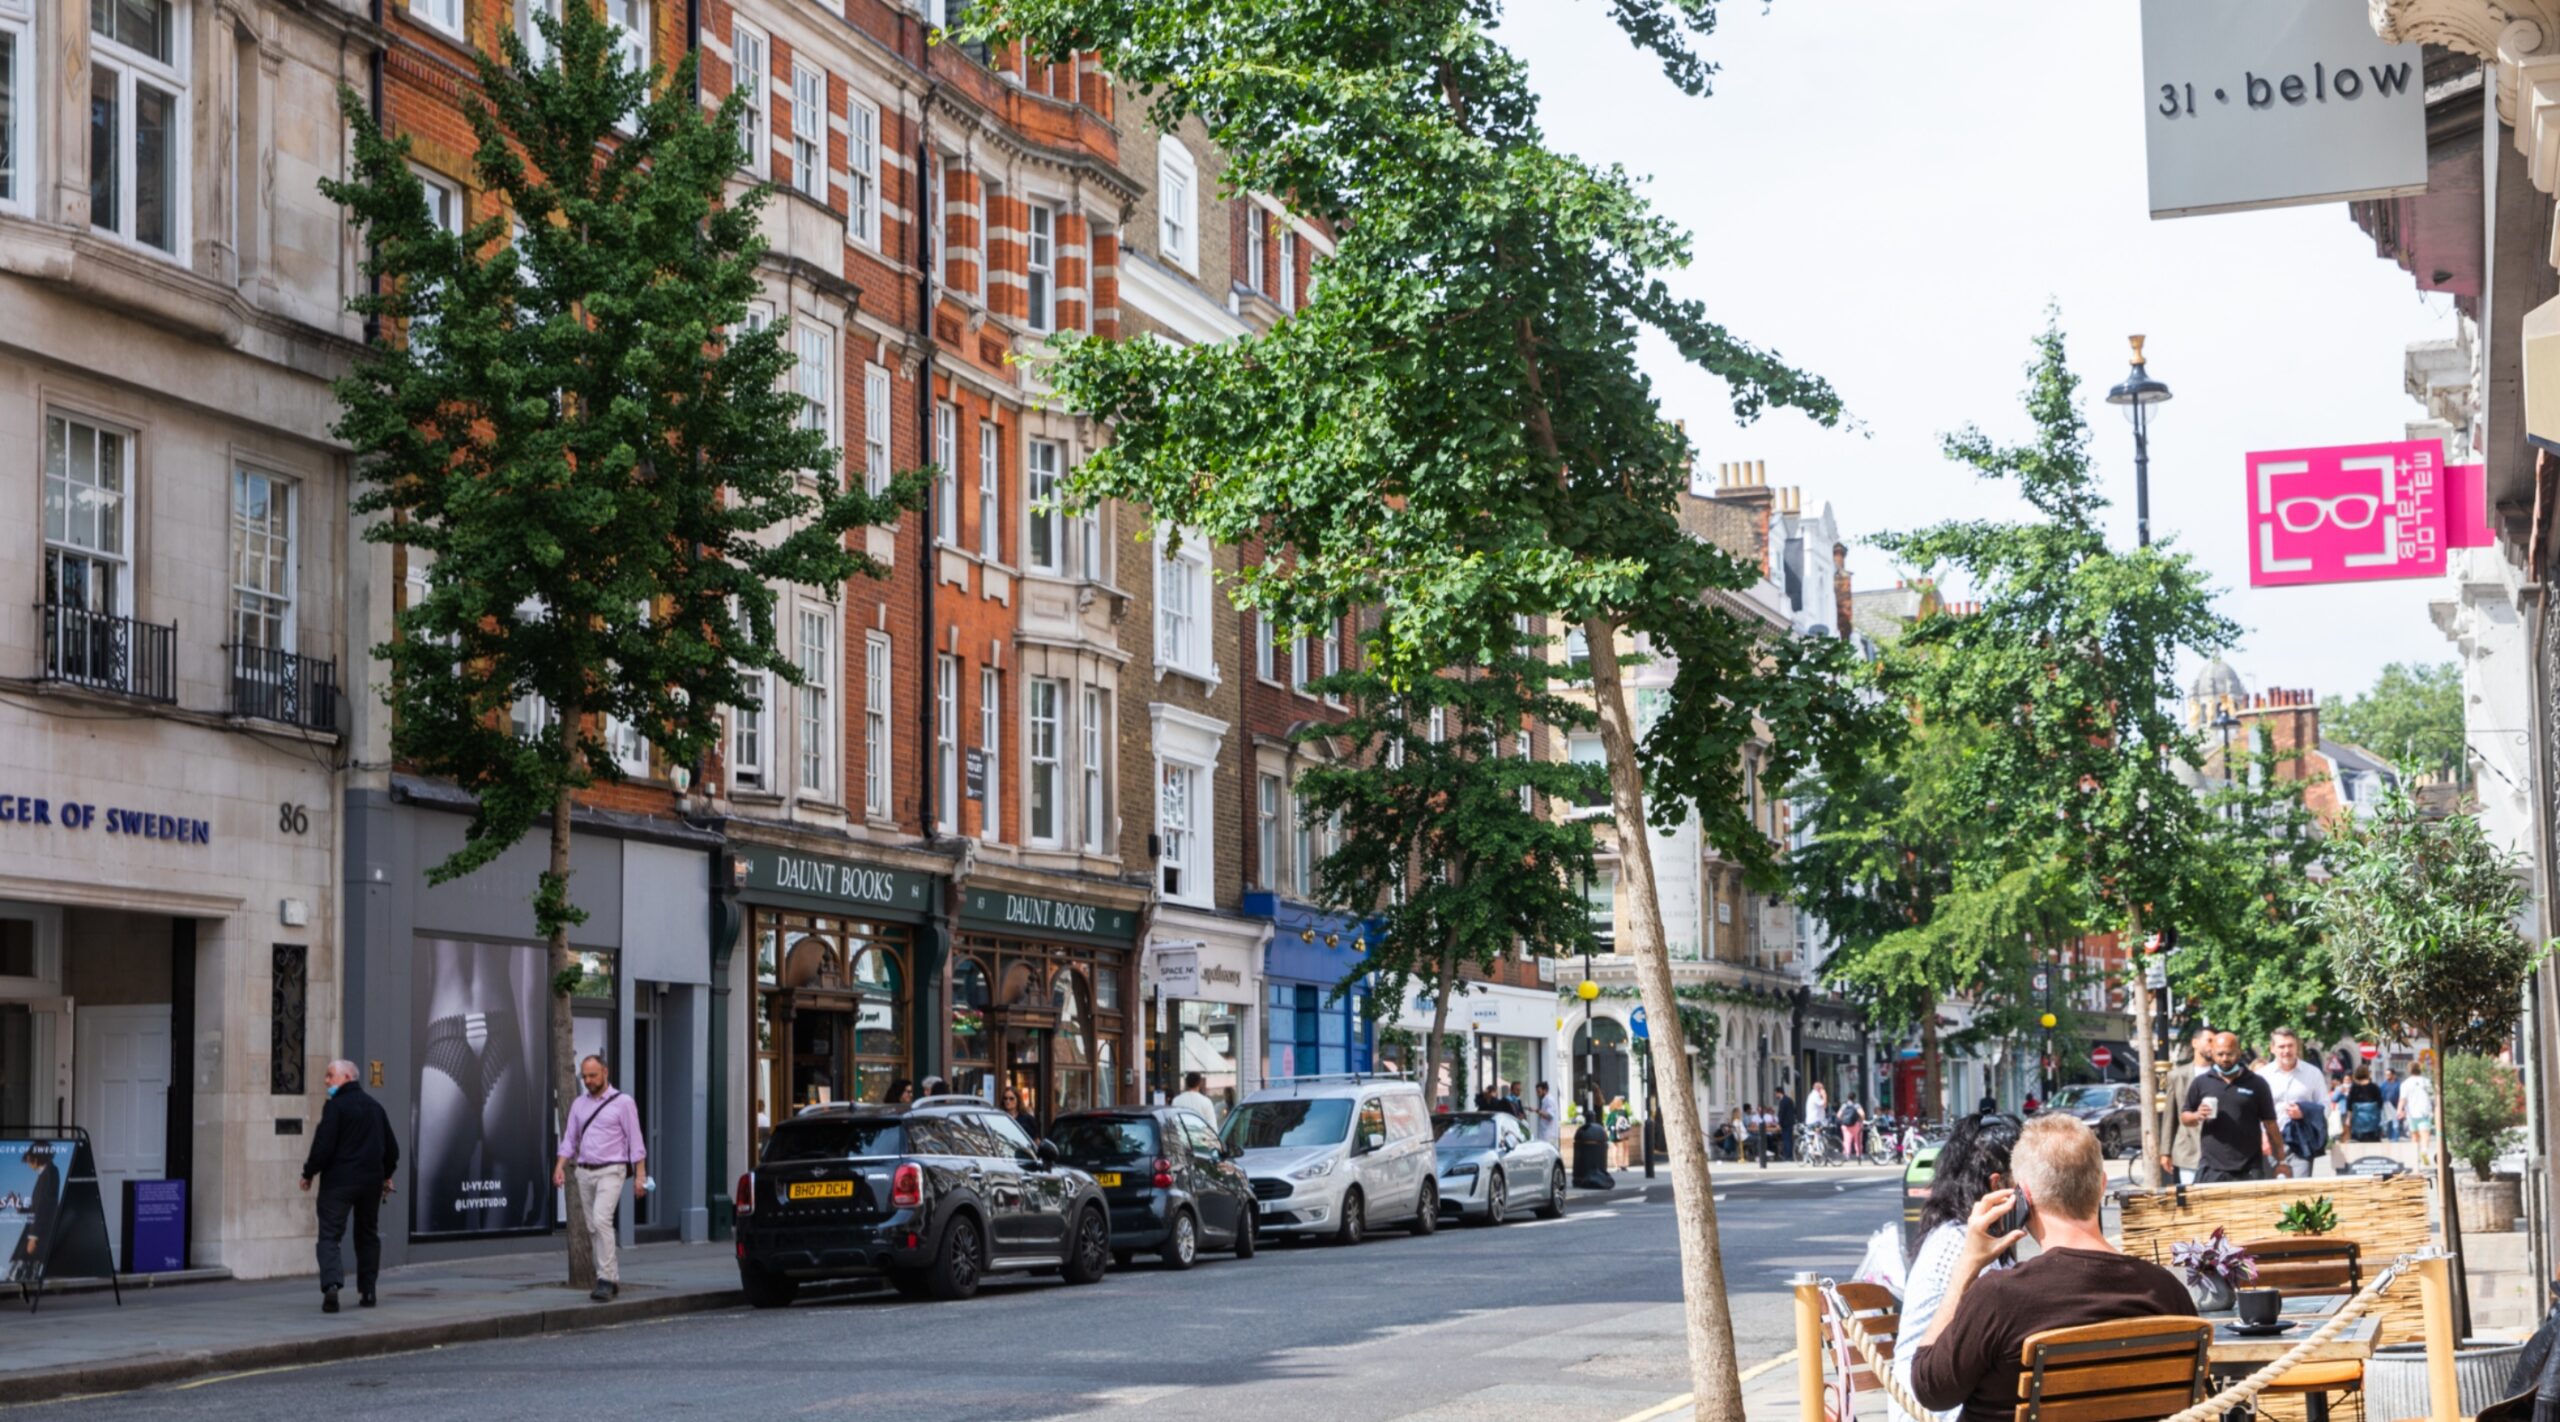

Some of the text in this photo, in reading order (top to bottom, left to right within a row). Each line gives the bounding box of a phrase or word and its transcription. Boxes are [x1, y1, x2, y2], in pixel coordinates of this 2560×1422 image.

[2158, 61, 2412, 117] 31 below
[0, 795, 209, 844] GER OF SWEDEN
[279, 802, 308, 834] 86
[776, 856, 835, 893] DAUNT
[841, 866, 894, 902] BOOKS
[1006, 894, 1052, 926] DAUNT
[1054, 902, 1096, 932] BOOKS
[0, 1196, 31, 1208] SALE
[455, 1197, 507, 1212] @LIVYSTUDIO
[794, 1183, 848, 1197] BH07 DCH
